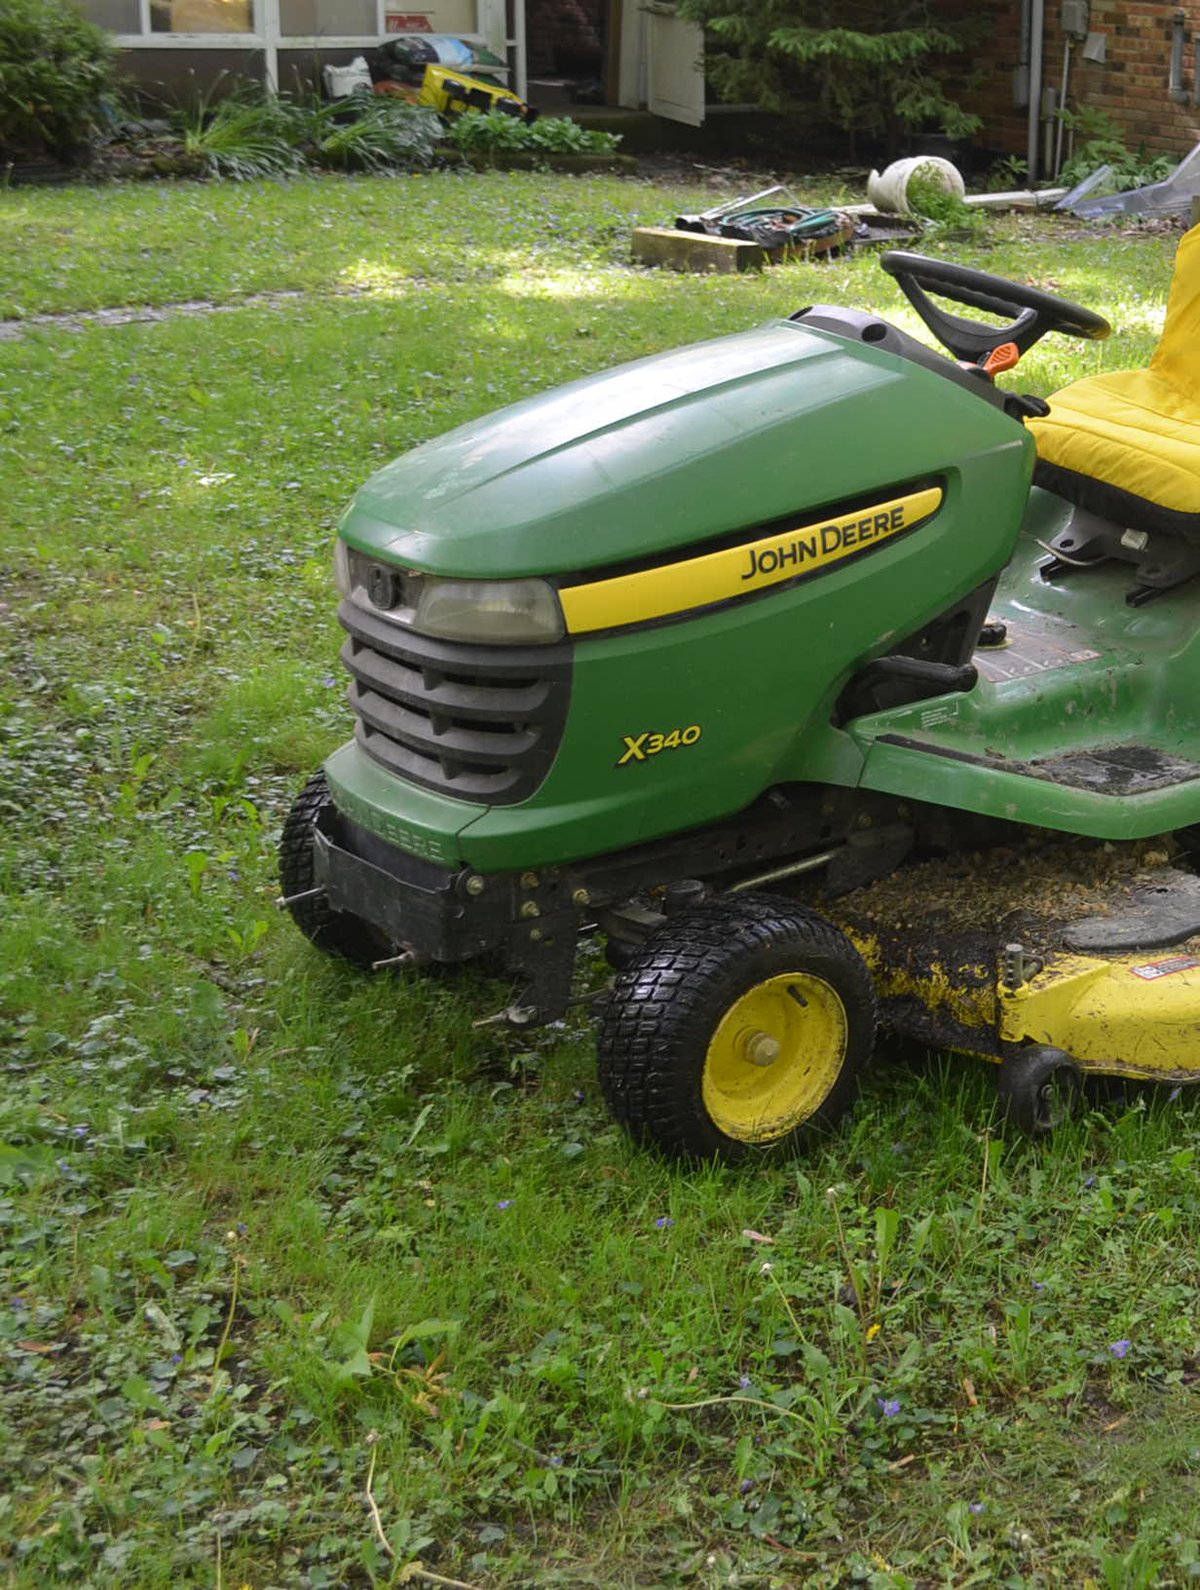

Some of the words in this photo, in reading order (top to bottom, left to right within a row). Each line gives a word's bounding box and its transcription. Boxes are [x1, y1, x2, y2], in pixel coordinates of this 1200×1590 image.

[741, 537, 817, 580] JOHN
[820, 506, 905, 555] DEERE
[617, 724, 702, 765] X340
